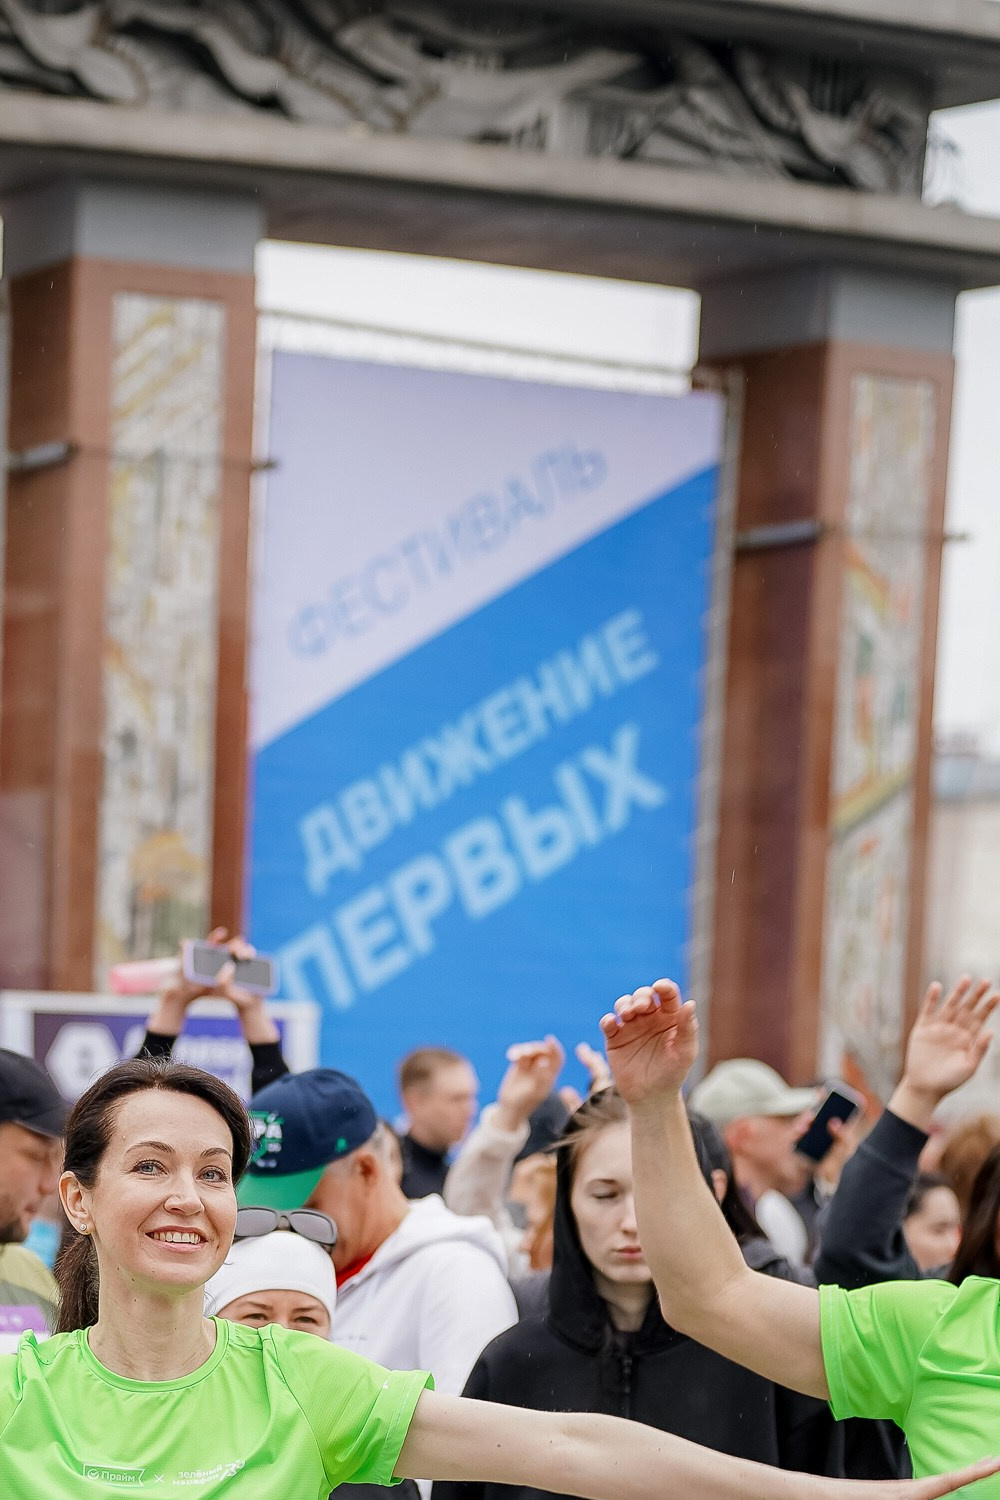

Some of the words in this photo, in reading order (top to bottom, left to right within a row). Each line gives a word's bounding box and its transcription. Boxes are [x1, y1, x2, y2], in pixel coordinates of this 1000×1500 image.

[287, 442, 608, 660] ФЕСТИВАЛЬ
[276, 723, 666, 1009] ПЕРВЫХ
[300, 609, 659, 894] ДВИЖЕНИЕ
[101, 1471, 136, 1482] Прайм
